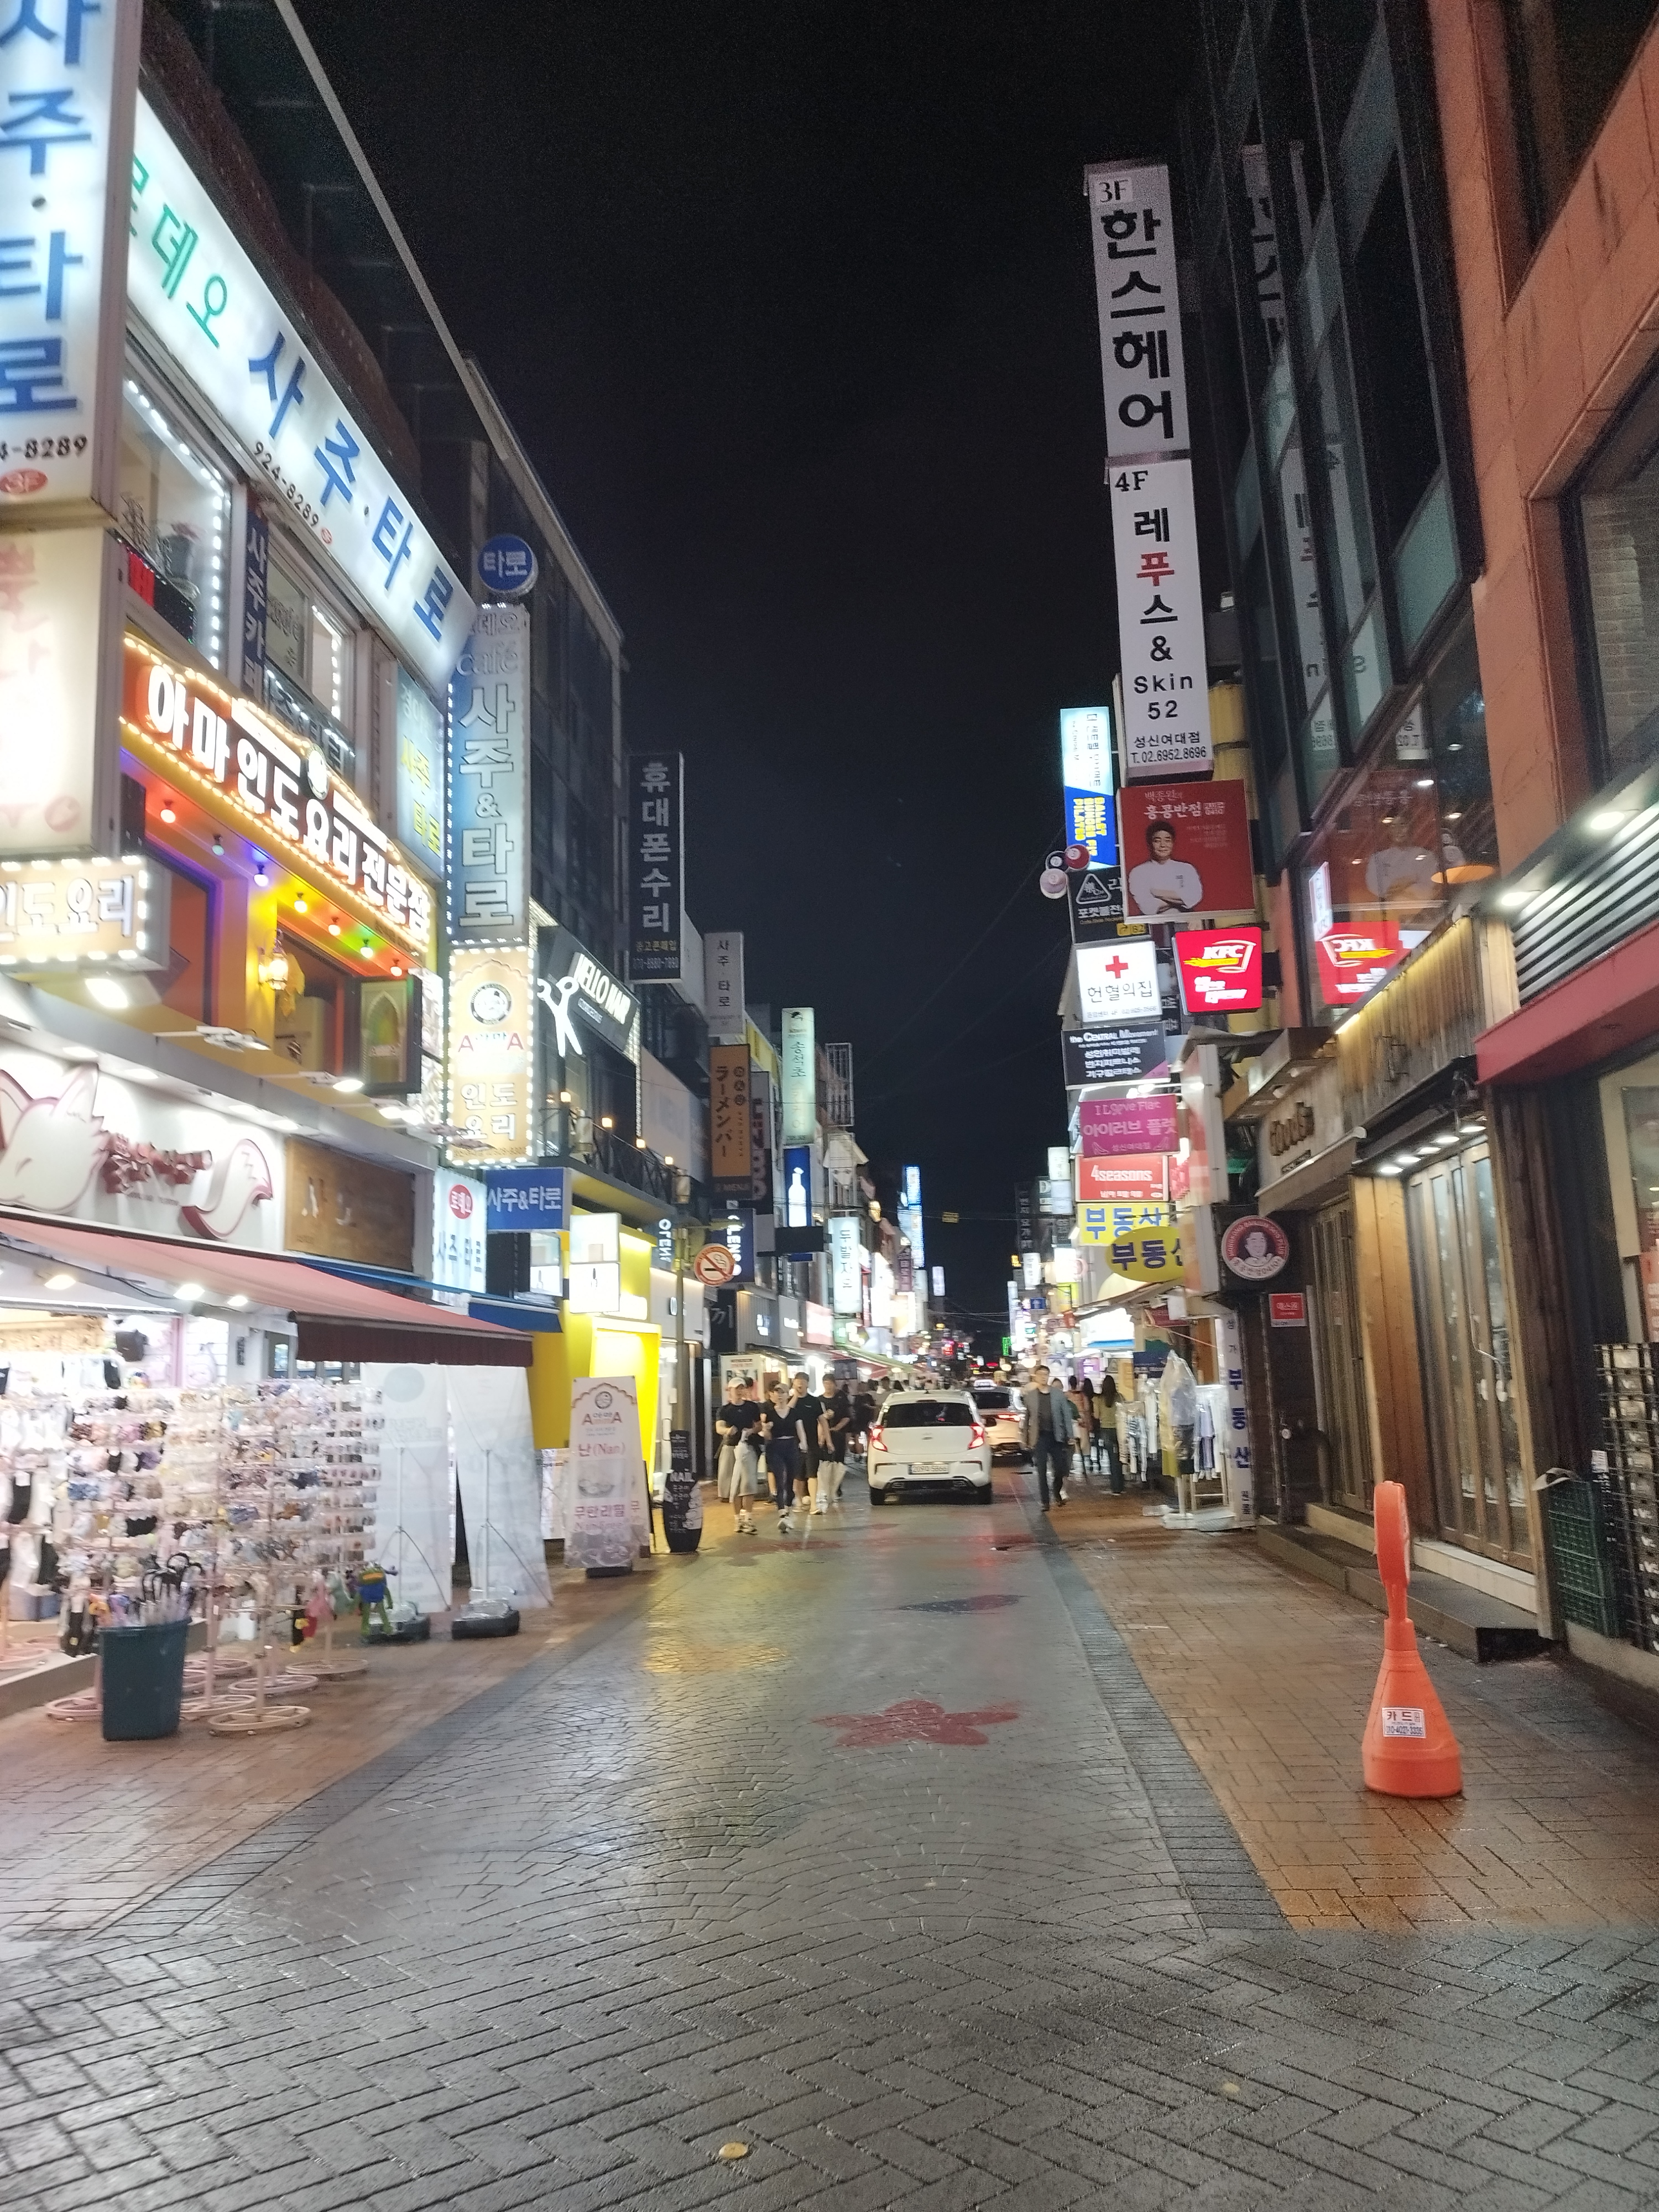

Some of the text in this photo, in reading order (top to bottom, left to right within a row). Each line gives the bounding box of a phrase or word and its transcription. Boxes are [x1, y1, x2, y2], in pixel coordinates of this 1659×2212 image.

[1098, 179, 1129, 203] 3F
[1100, 208, 1174, 440] 한스헤어
[254, 441, 319, 526] 924-8289
[1115, 470, 1149, 492] 4F
[483, 550, 528, 578] 타로
[1134, 672, 1193, 695] Skin
[1147, 700, 1178, 720] 52
[148, 665, 231, 783] 아마
[1135, 731, 1201, 748] 성신여대점
[459, 684, 515, 928] 사주&타로
[1144, 801, 1202, 820] 홍콩반점
[640, 763, 671, 933] 휴대폰수리
[1202, 945, 1245, 959] KFC
[1088, 980, 1153, 1003] 헌혈의집
[460, 1082, 518, 1110] 인도
[456, 1113, 516, 1140] 요리
[1083, 1118, 1177, 1137] 아이러브 플랫
[1091, 1165, 1153, 1181] 4seasons
[487, 1186, 562, 1212] 사주&타로
[1228, 1369, 1251, 1469] 부동산
[575, 1504, 624, 1519] 무한리필
[1386, 1711, 1412, 1721] 카드
